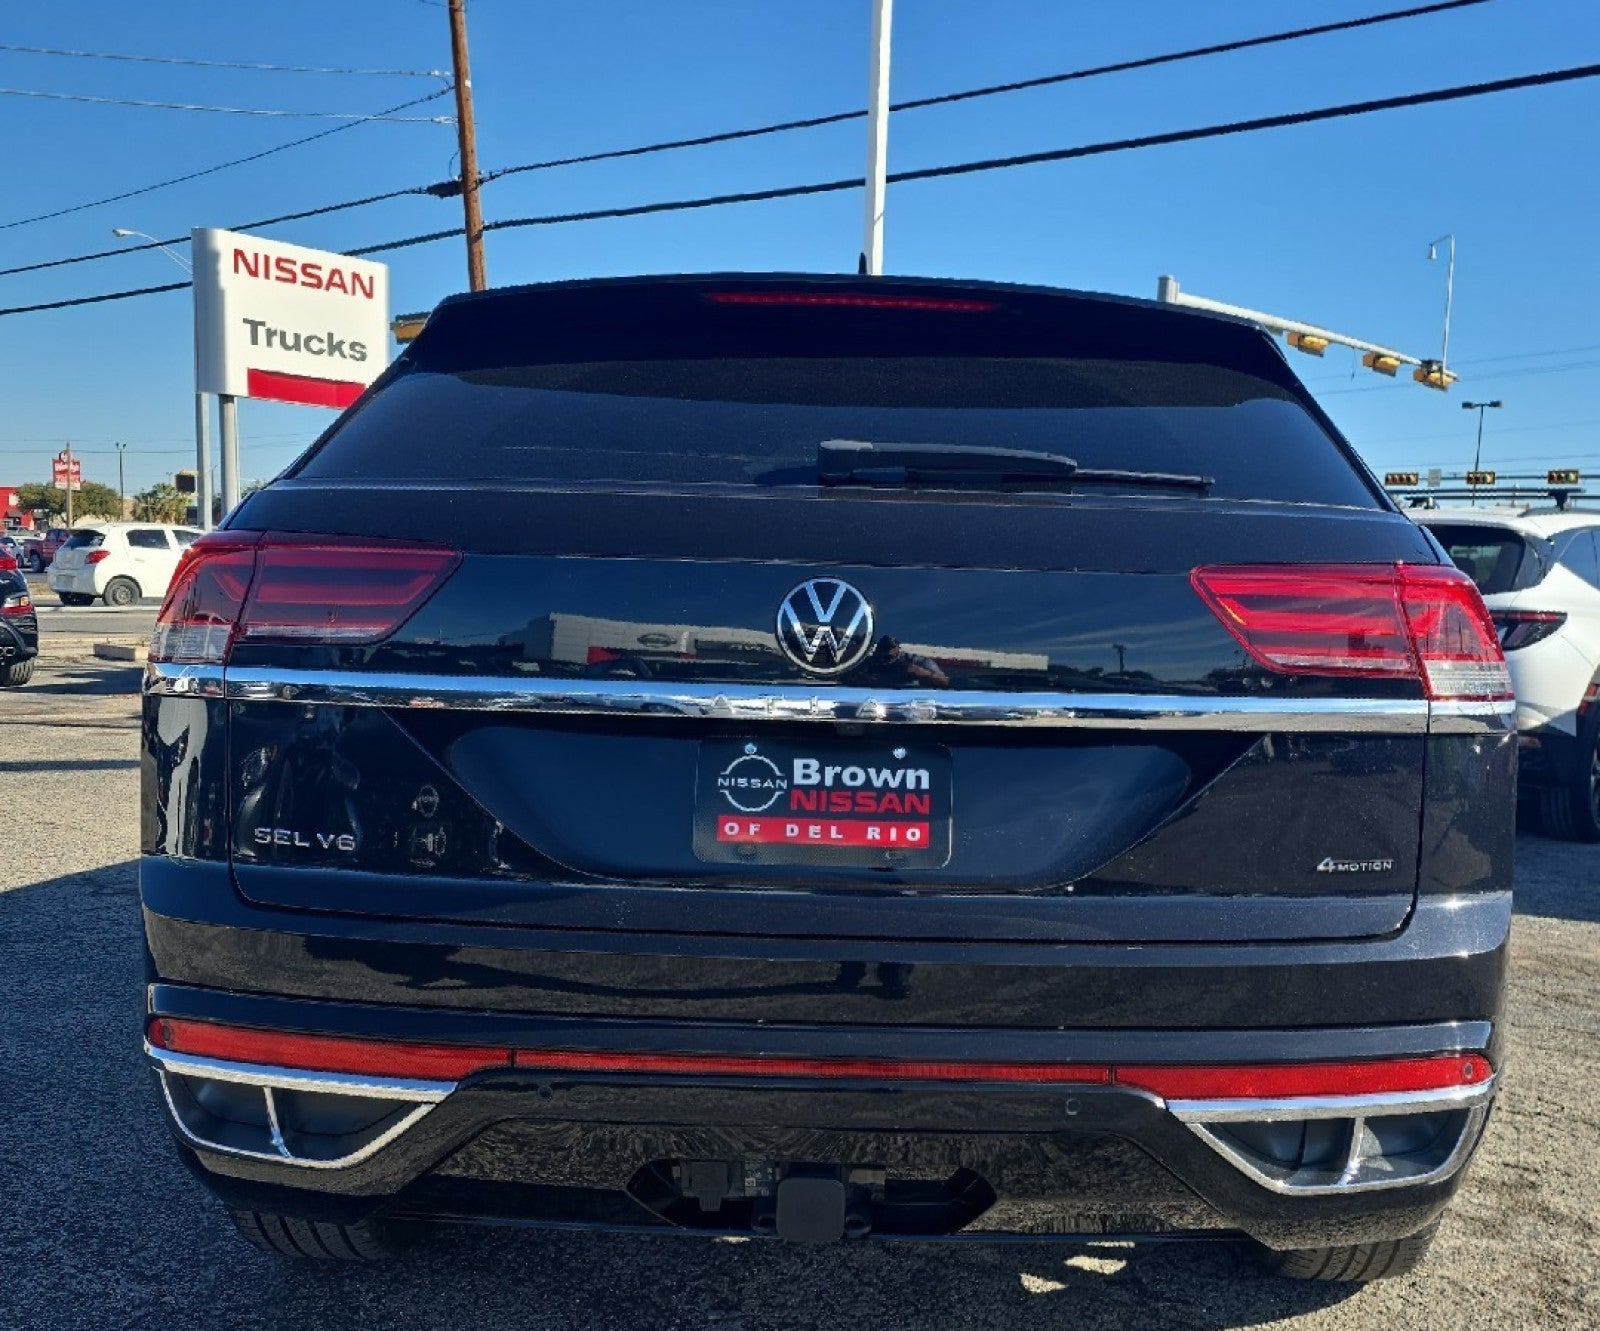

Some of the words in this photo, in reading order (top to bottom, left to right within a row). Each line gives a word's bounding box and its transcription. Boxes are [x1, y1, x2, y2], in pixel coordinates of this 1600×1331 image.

[233, 248, 374, 300] NISSAN
[242, 317, 368, 362] Trucks
[717, 776, 788, 790] NISSAN
[793, 758, 930, 790] Brown
[790, 790, 930, 815] NISSAN
[254, 827, 310, 848] SEL
[316, 833, 356, 851] V6
[723, 822, 762, 836] OF
[786, 824, 844, 839] DEL
[867, 826, 921, 842] RIO
[1316, 856, 1393, 873] 4MOTION
